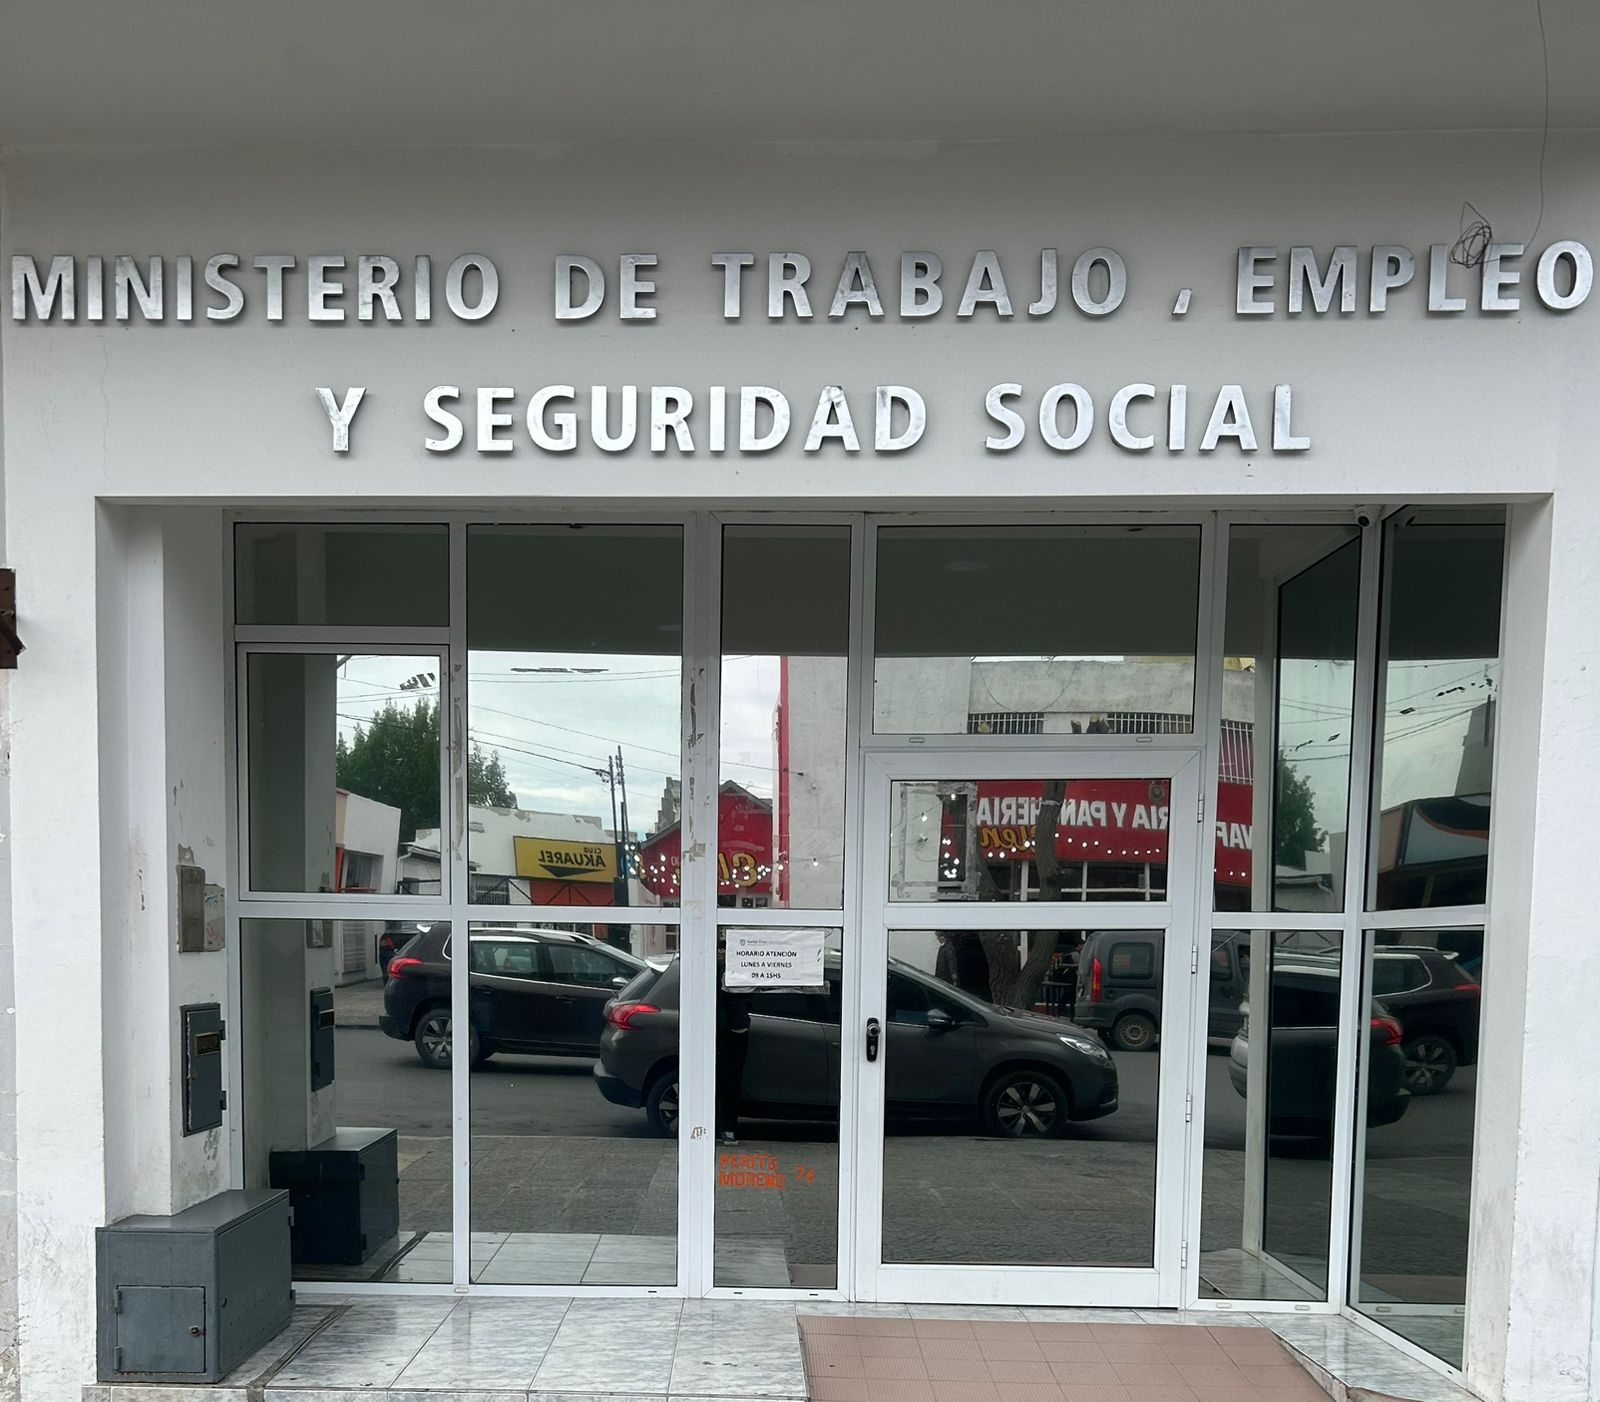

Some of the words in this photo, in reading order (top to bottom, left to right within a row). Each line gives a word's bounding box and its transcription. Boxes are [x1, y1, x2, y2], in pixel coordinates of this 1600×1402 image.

[11, 253, 499, 321] MINISTERIO
[554, 254, 659, 320] DE
[711, 247, 1127, 319] TRABAJO
[1236, 240, 1594, 314] EMPLEO
[316, 387, 366, 452] Y
[425, 384, 926, 452] SEGURIDAD
[985, 383, 1310, 452] SOCIAL
[719, 1153, 778, 1171] PERITO
[719, 1171, 786, 1190] MORENO
